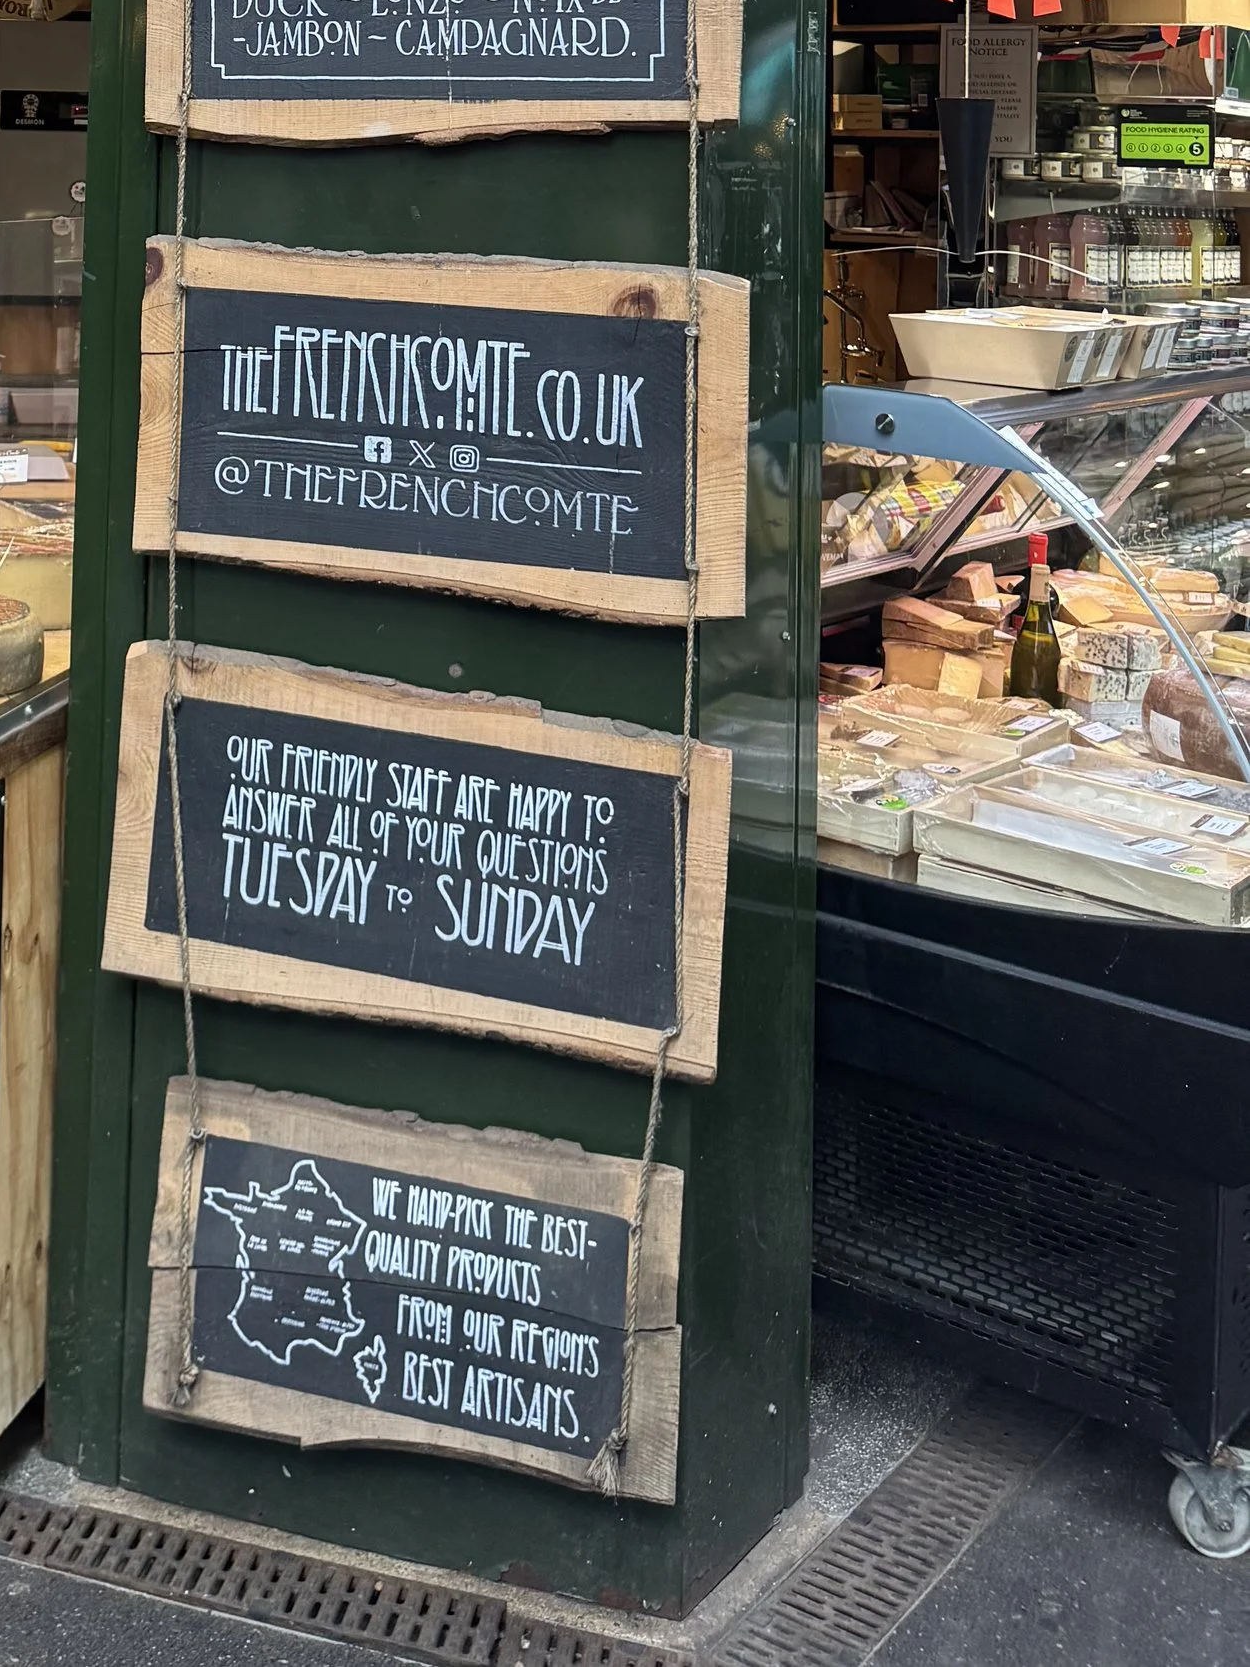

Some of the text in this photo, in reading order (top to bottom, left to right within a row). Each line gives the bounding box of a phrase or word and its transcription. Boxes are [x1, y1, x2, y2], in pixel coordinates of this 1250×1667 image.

[983, 38, 1026, 46] ALLERGY
[1192, 144, 1201, 155] 5
[214, 456, 639, 536] @THEFRENCHCOMTE
[227, 735, 614, 844] OUR FRIENDLY STAFF ARE HAPPY TO
[222, 784, 608, 896] ANSWER ALL OF YOUR QUESTIONS
[222, 833, 596, 966] TUESDAY TO SUNDAY
[372, 1178, 401, 1221] WE
[407, 1183, 493, 1239] HAND-PICK
[504, 1204, 538, 1246] THE
[365, 1230, 440, 1284] QUALITY
[448, 1245, 541, 1307] PRODUCTS
[397, 1294, 599, 1378] FROM OUR REGION'S
[402, 1352, 454, 1410] BEST
